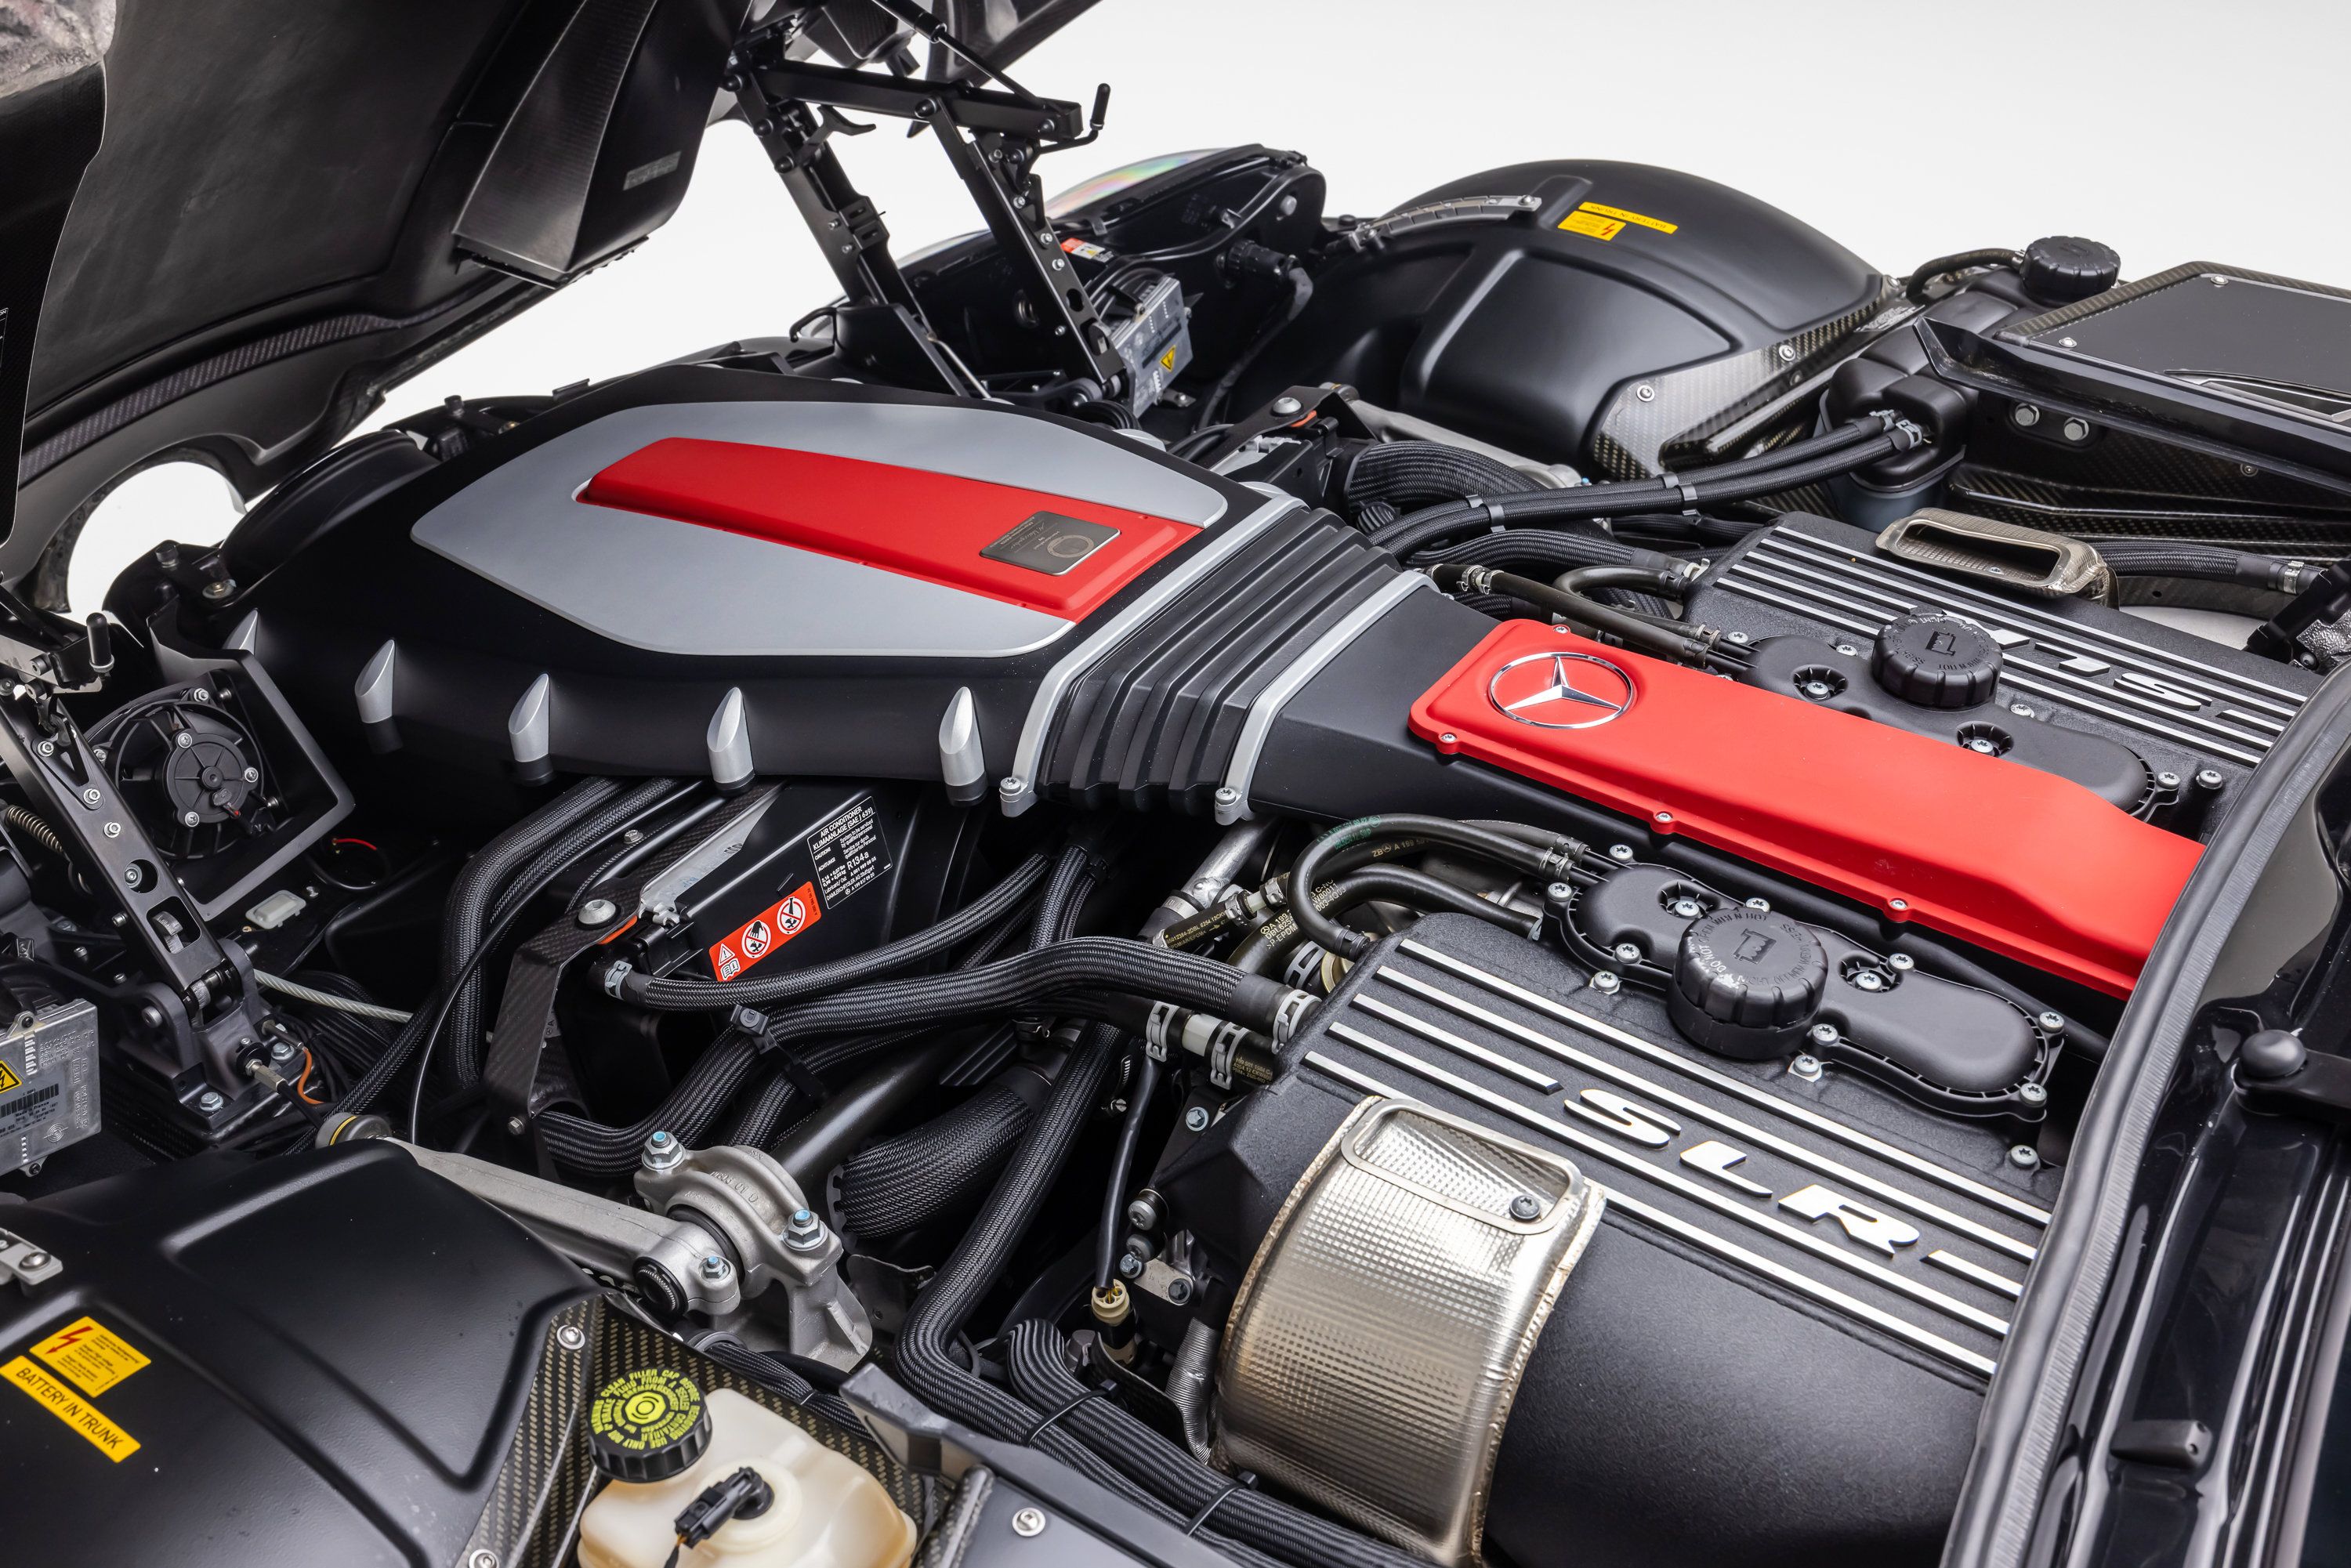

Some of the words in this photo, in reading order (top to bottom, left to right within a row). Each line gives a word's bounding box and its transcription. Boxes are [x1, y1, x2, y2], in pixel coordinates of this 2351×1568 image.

[813, 824, 847, 850] KLIMAANLAGE
[847, 817, 859, 828] (SAE
[861, 806, 873, 819] 639)
[820, 827, 829, 837] AIR
[828, 806, 862, 831] CONDITIONER
[840, 833, 852, 844] System
[1371, 849, 1384, 857] ZB
[1401, 839, 1415, 848] 199
[843, 845, 855, 854] Service
[846, 849, 869, 870] R134a
[1274, 913, 1288, 925] 199
[1698, 943, 1713, 963] NOT
[1712, 960, 1727, 973] DO
[1564, 1088, 1920, 1258] SLR
[629, 1368, 657, 1380] FILLER
[661, 1369, 680, 1380] CAP
[600, 1377, 626, 1398] CLEAN
[612, 1380, 637, 1397] FLUID
[640, 1376, 667, 1385] FROM
[668, 1380, 678, 1389] A
[16, 1367, 68, 1406] BATTERY
[63, 1402, 82, 1418] IN
[78, 1412, 124, 1450] TRUNK
[622, 1438, 646, 1450] ONLY
